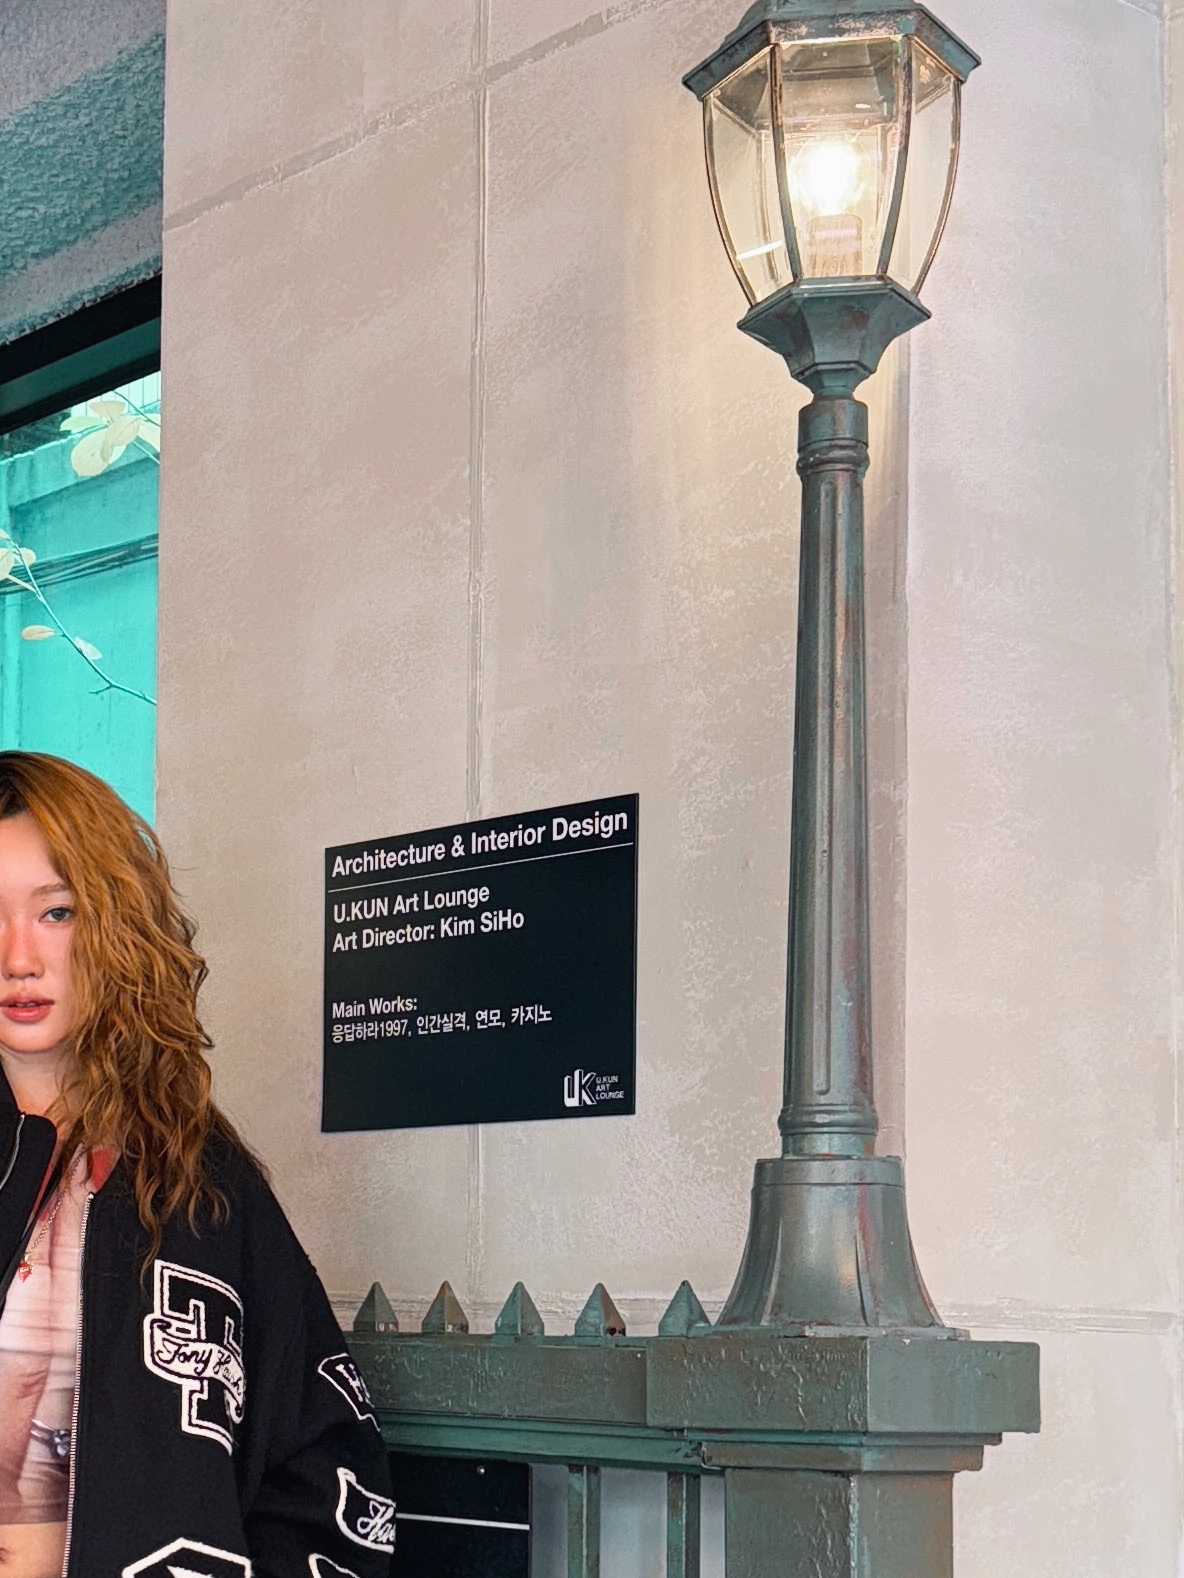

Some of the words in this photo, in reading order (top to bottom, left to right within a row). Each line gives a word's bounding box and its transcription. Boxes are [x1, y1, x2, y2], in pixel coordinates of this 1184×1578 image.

[331, 844, 446, 878] Architecture
[451, 834, 466, 858] &
[471, 823, 547, 855] Interior
[552, 811, 628, 841] Design
[333, 896, 389, 924] U.KUN
[392, 893, 420, 915] Art
[424, 886, 491, 911] Lounge
[332, 931, 358, 953] Art
[362, 923, 435, 949] Director:
[440, 916, 476, 939] Kim
[480, 908, 526, 933] SiHo
[331, 1019, 412, 1044] 응답하라1997,
[416, 1011, 471, 1036] 인간실격,
[475, 1009, 506, 1029] 연모,
[511, 1004, 553, 1026] 카지노
[332, 1000, 366, 1019] Main
[368, 995, 418, 1015] Works:
